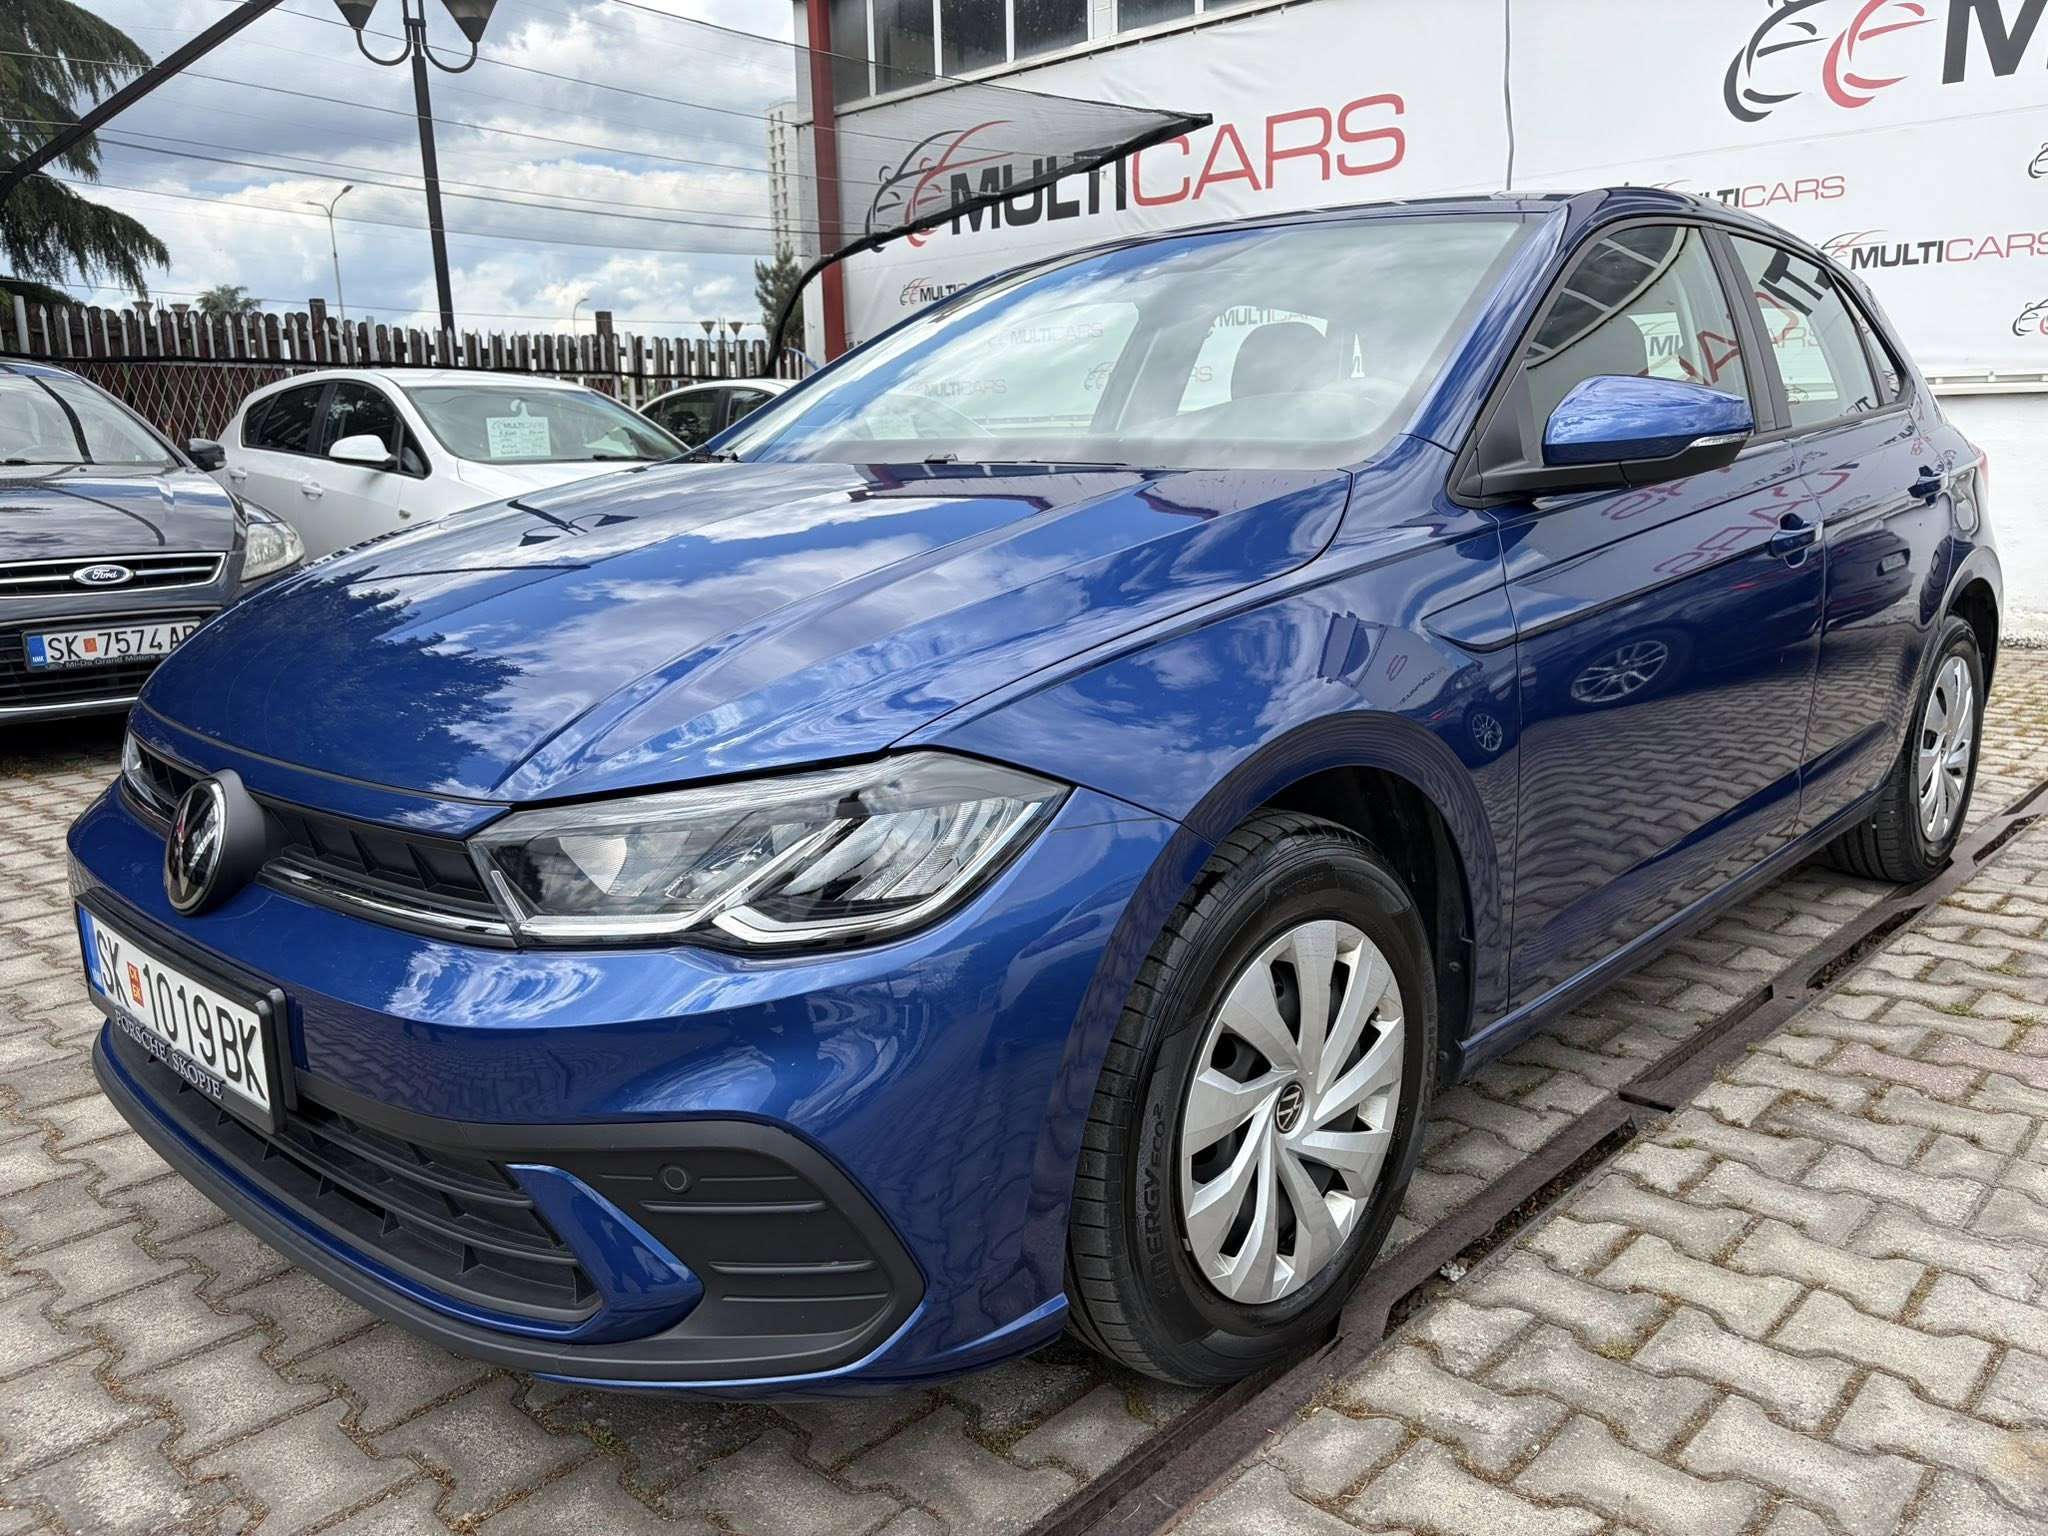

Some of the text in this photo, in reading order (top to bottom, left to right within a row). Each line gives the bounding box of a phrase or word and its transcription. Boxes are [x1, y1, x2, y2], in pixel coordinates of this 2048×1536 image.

[950, 93, 1407, 236] MULTICARS
[1698, 175, 1845, 208] TICARS
[91, 569, 118, 580] Ford
[48, 635, 80, 661] SK
[97, 629, 163, 655] 7574
[97, 929, 131, 1009] SK
[114, 1010, 226, 1100] PORSCHE SKOPJE
